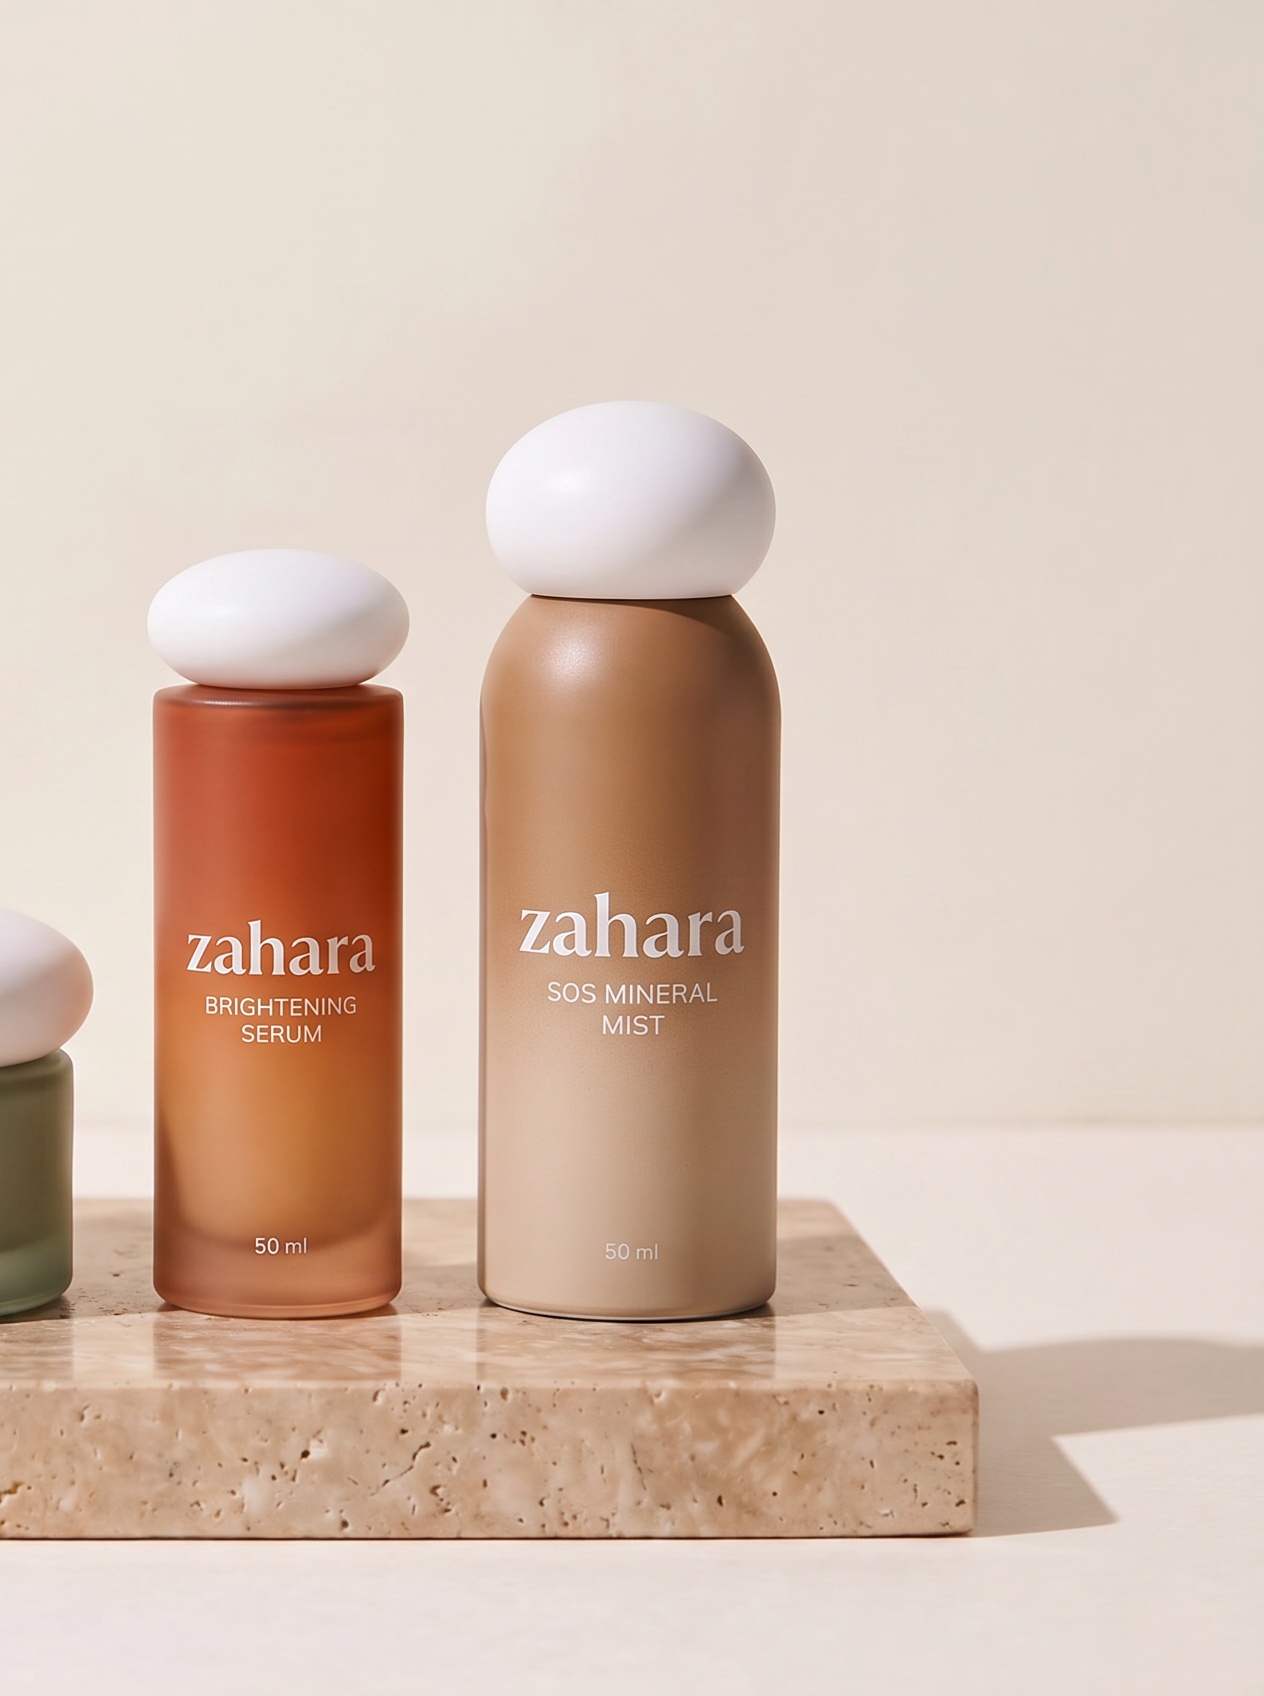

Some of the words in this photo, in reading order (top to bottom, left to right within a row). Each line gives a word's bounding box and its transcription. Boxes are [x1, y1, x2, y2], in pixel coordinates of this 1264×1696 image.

[519, 891, 745, 958] zahara
[186, 919, 376, 976] zahara
[547, 981, 597, 1004] SOS
[605, 982, 718, 1004] MINERAL
[205, 996, 357, 1016] BRIGHTENING
[241, 1024, 323, 1043] SERUM
[602, 1014, 665, 1036] MIST
[254, 1237, 279, 1255] 50
[285, 1237, 308, 1254] ml
[604, 1243, 631, 1261] 50
[636, 1243, 659, 1260] ml
